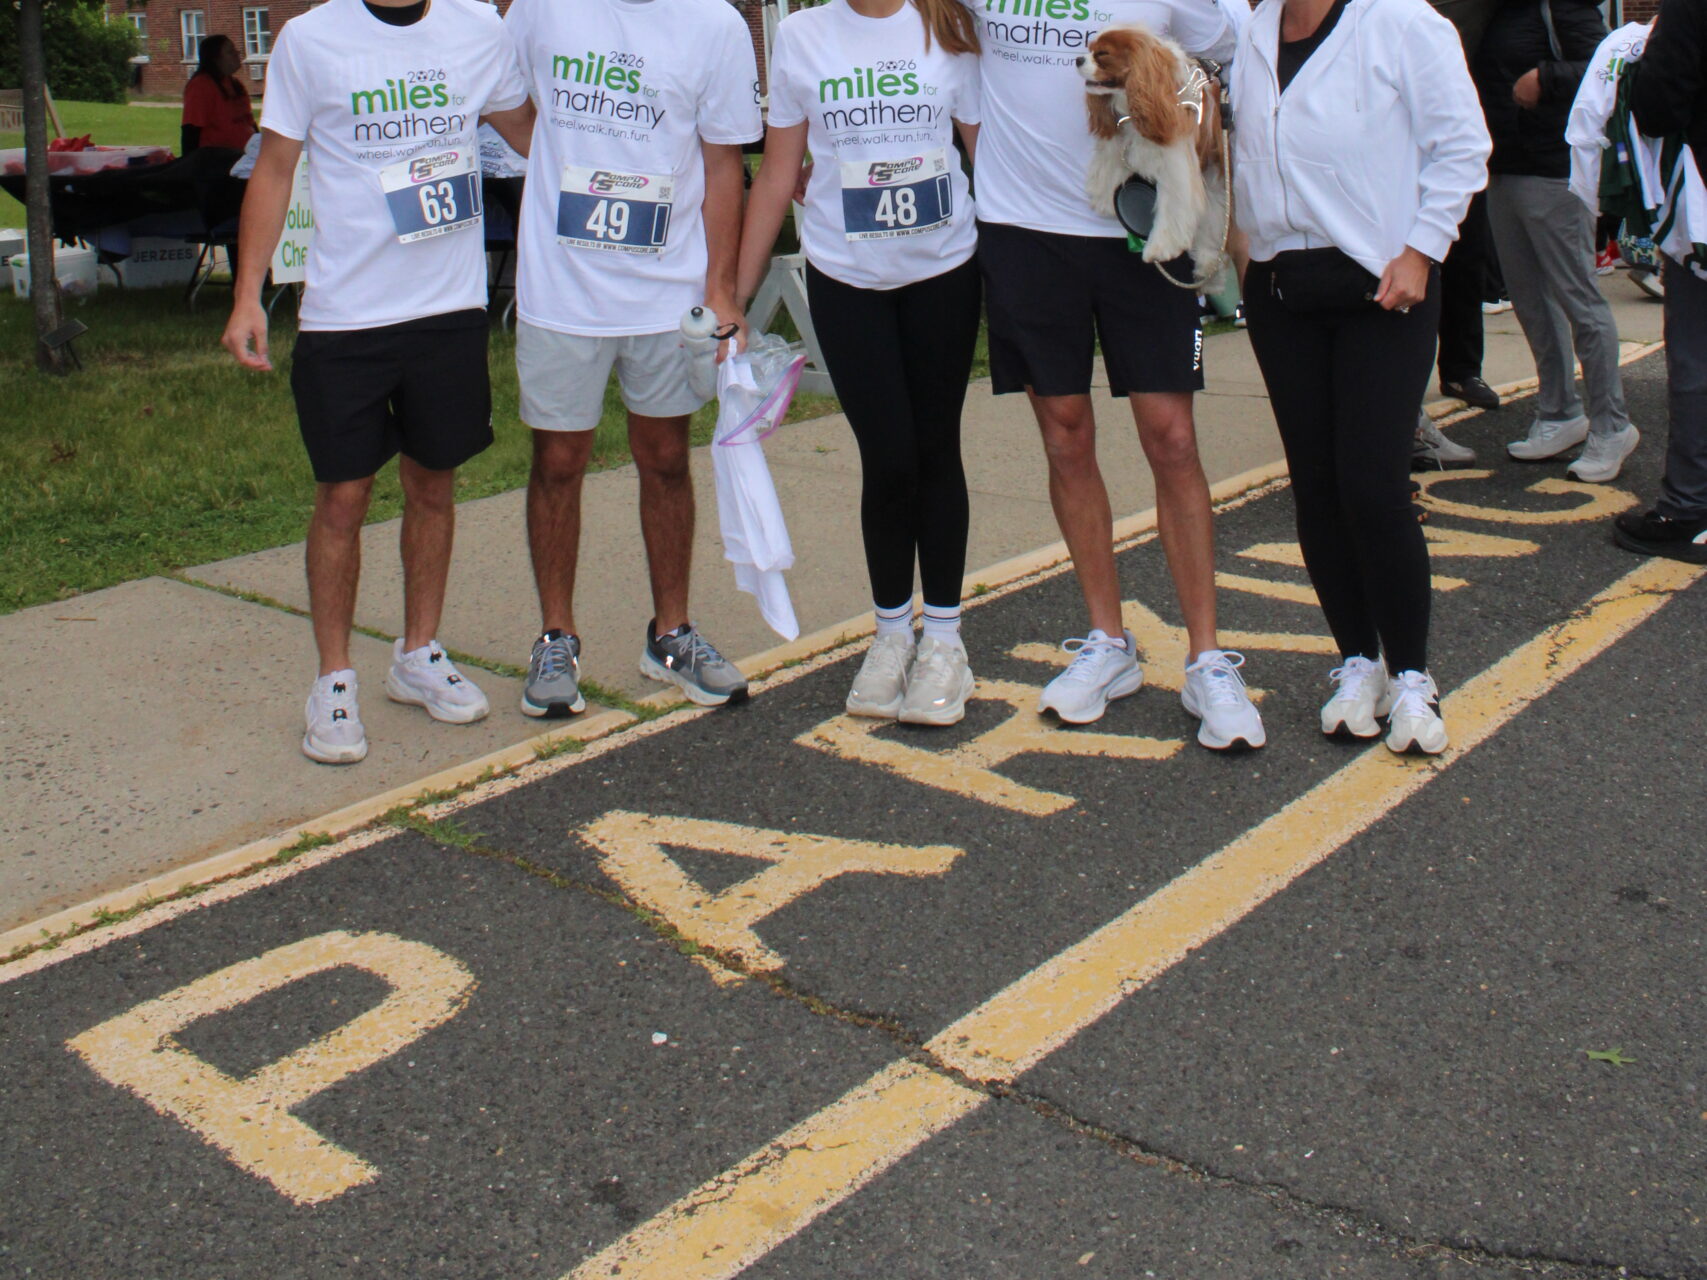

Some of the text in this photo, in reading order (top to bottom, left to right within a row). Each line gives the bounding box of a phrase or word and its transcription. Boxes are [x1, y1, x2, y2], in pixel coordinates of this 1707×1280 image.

[1094, 10, 1113, 22] for
[987, 21, 1097, 48] mathe
[553, 51, 660, 99] miles for
[819, 67, 939, 103] miles for
[351, 78, 449, 115] miles
[552, 88, 665, 130] matheny
[823, 100, 943, 129] matheny
[419, 181, 457, 225] 63
[586, 199, 630, 241] 49
[875, 187, 918, 227] 48
[134, 248, 193, 263] JERZEES
[282, 240, 308, 268] Che
